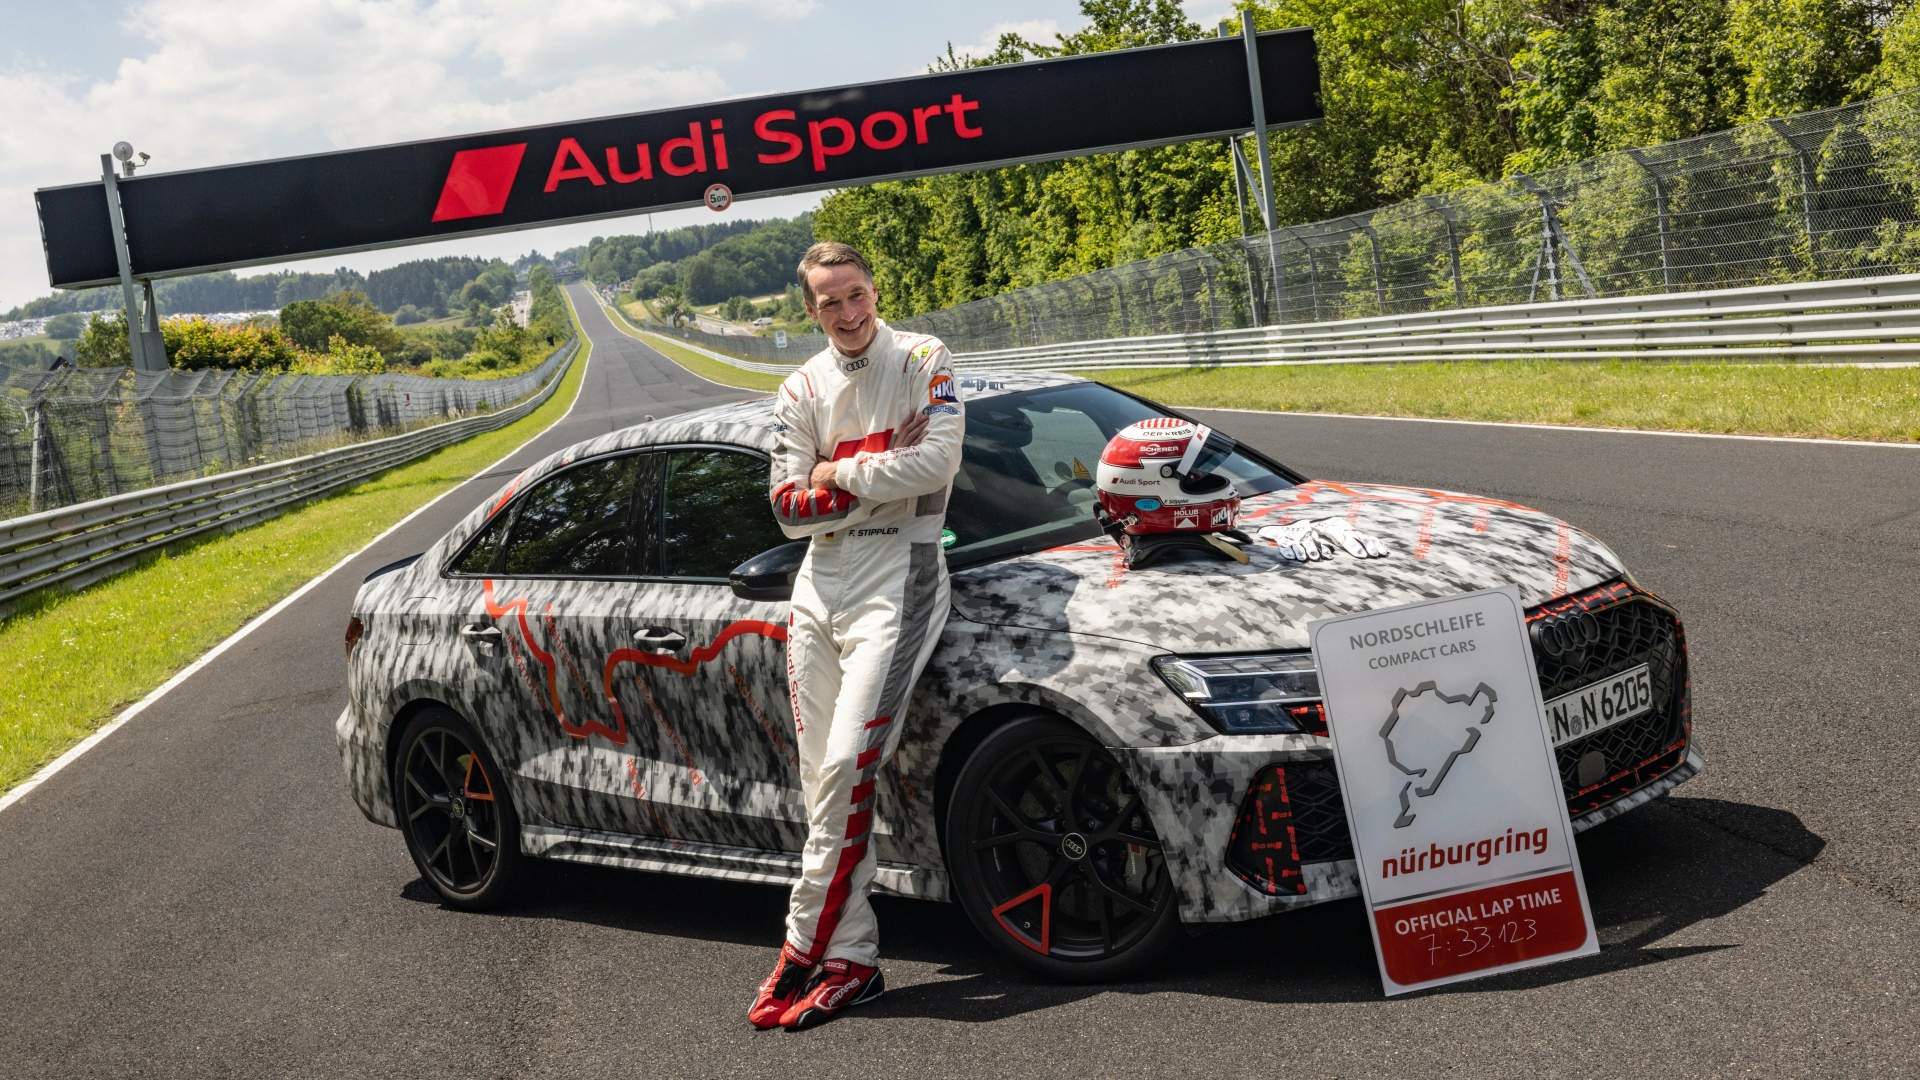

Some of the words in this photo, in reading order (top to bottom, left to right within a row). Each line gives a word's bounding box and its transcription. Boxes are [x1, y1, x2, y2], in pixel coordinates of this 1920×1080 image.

[543, 118, 730, 194] Audi
[754, 93, 983, 172] Sport
[1140, 445, 1179, 453] SCHERER
[1165, 428, 1192, 436] KREIS
[1173, 508, 1199, 516] HOLUB
[848, 529, 856, 537] F.
[857, 527, 899, 537] STIPPLER
[1349, 611, 1486, 650] NORDSCHLEIFE
[1368, 646, 1437, 670] COMPACT
[1439, 639, 1476, 656] CARS
[727, 663, 790, 753] #Adenauer
[790, 680, 805, 736] Sport
[1580, 691, 1598, 730] N
[1601, 670, 1650, 721] 6205
[1382, 827, 1548, 879] nürburgring
[1394, 906, 1478, 936] OFFICIAL
[1480, 898, 1514, 919] LAP
[1516, 888, 1563, 910] TIME
[828, 977, 860, 1009] ASTARS
